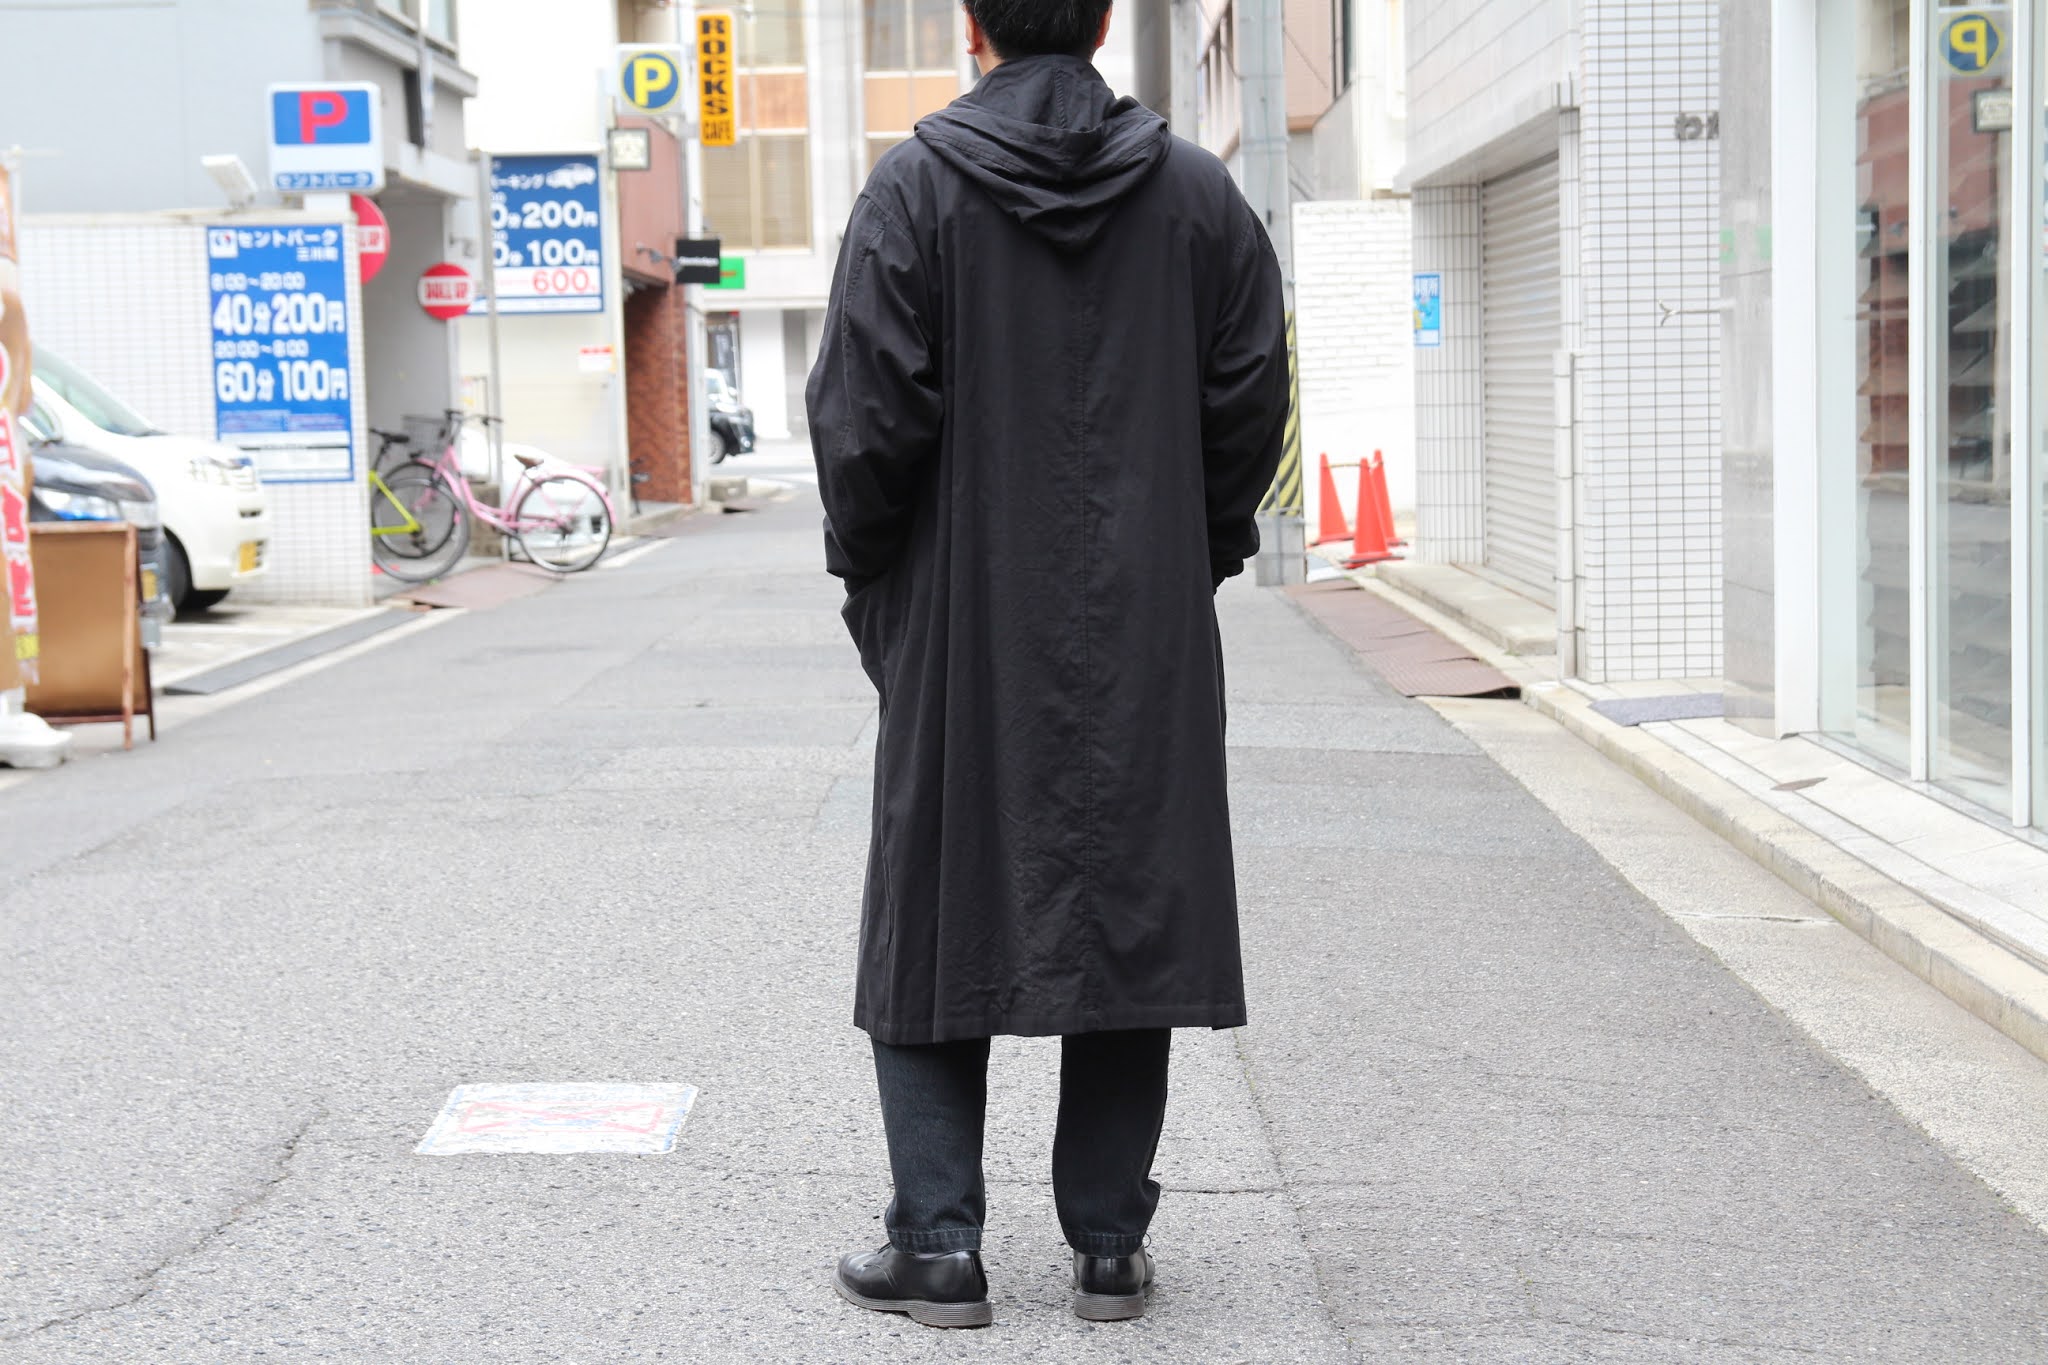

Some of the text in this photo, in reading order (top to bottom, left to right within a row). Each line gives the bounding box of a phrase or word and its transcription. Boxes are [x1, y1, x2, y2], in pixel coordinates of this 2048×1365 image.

[633, 58, 672, 106] P
[702, 19, 728, 115] ROCKS
[300, 91, 348, 143] P
[238, 229, 338, 248] セントパーク
